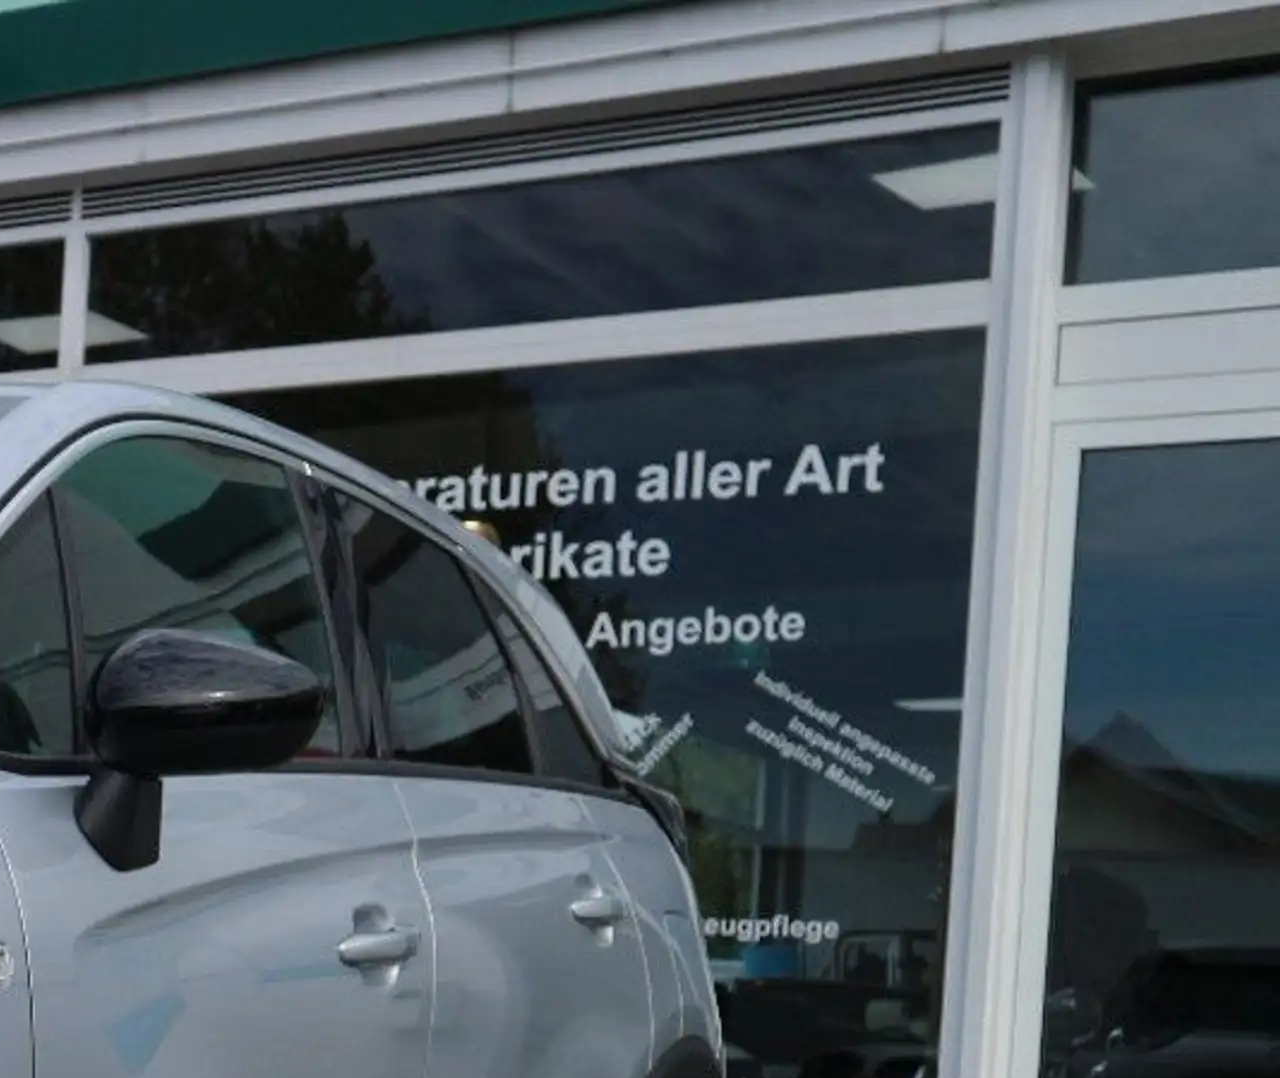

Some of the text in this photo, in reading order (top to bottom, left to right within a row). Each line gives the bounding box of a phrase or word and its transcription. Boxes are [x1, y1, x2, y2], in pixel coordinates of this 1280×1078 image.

[396, 442, 886, 514] raturen aller Art
[586, 605, 806, 656] Angebote
